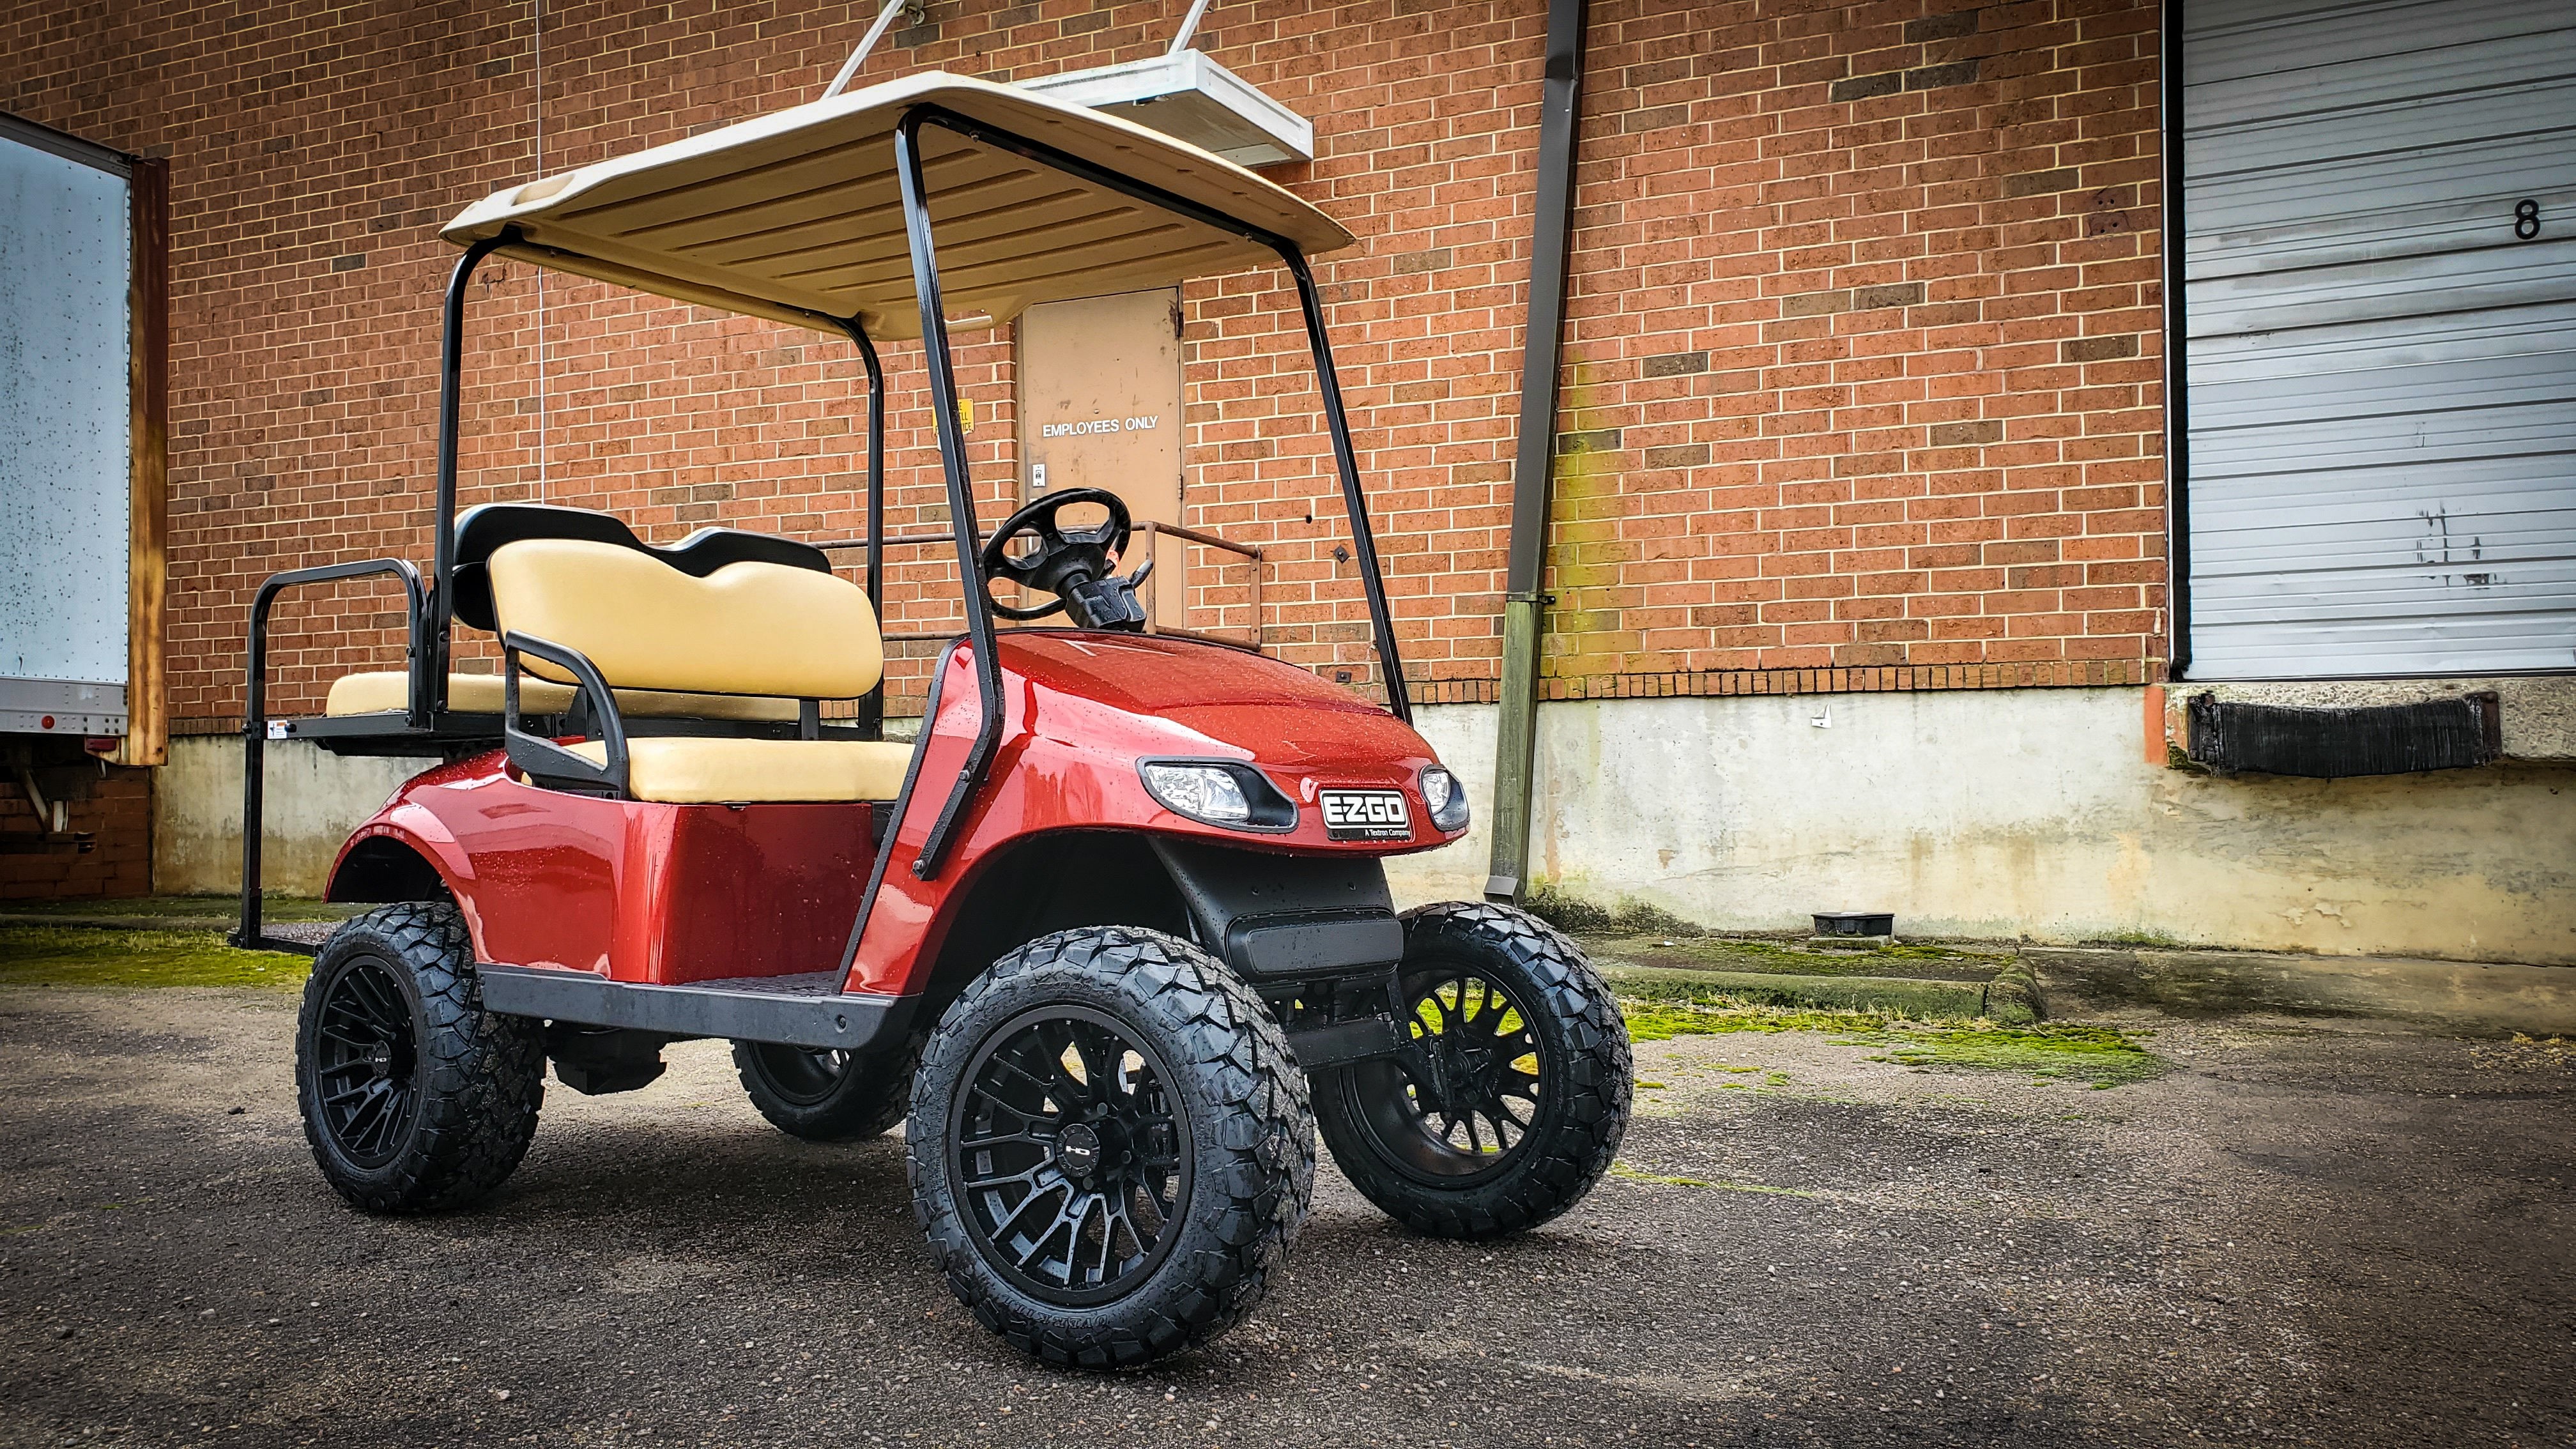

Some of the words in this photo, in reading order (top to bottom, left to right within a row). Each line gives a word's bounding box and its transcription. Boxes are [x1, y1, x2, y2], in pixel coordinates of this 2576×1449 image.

[2515, 199, 2540, 240] 8
[1042, 418, 1119, 438] EMPLOYEES
[1124, 415, 1159, 430] ONLY
[1388, 829, 1411, 838] Company
[1066, 1146, 1091, 1156] HD
[1002, 1294, 1108, 1329] OVERKILL
